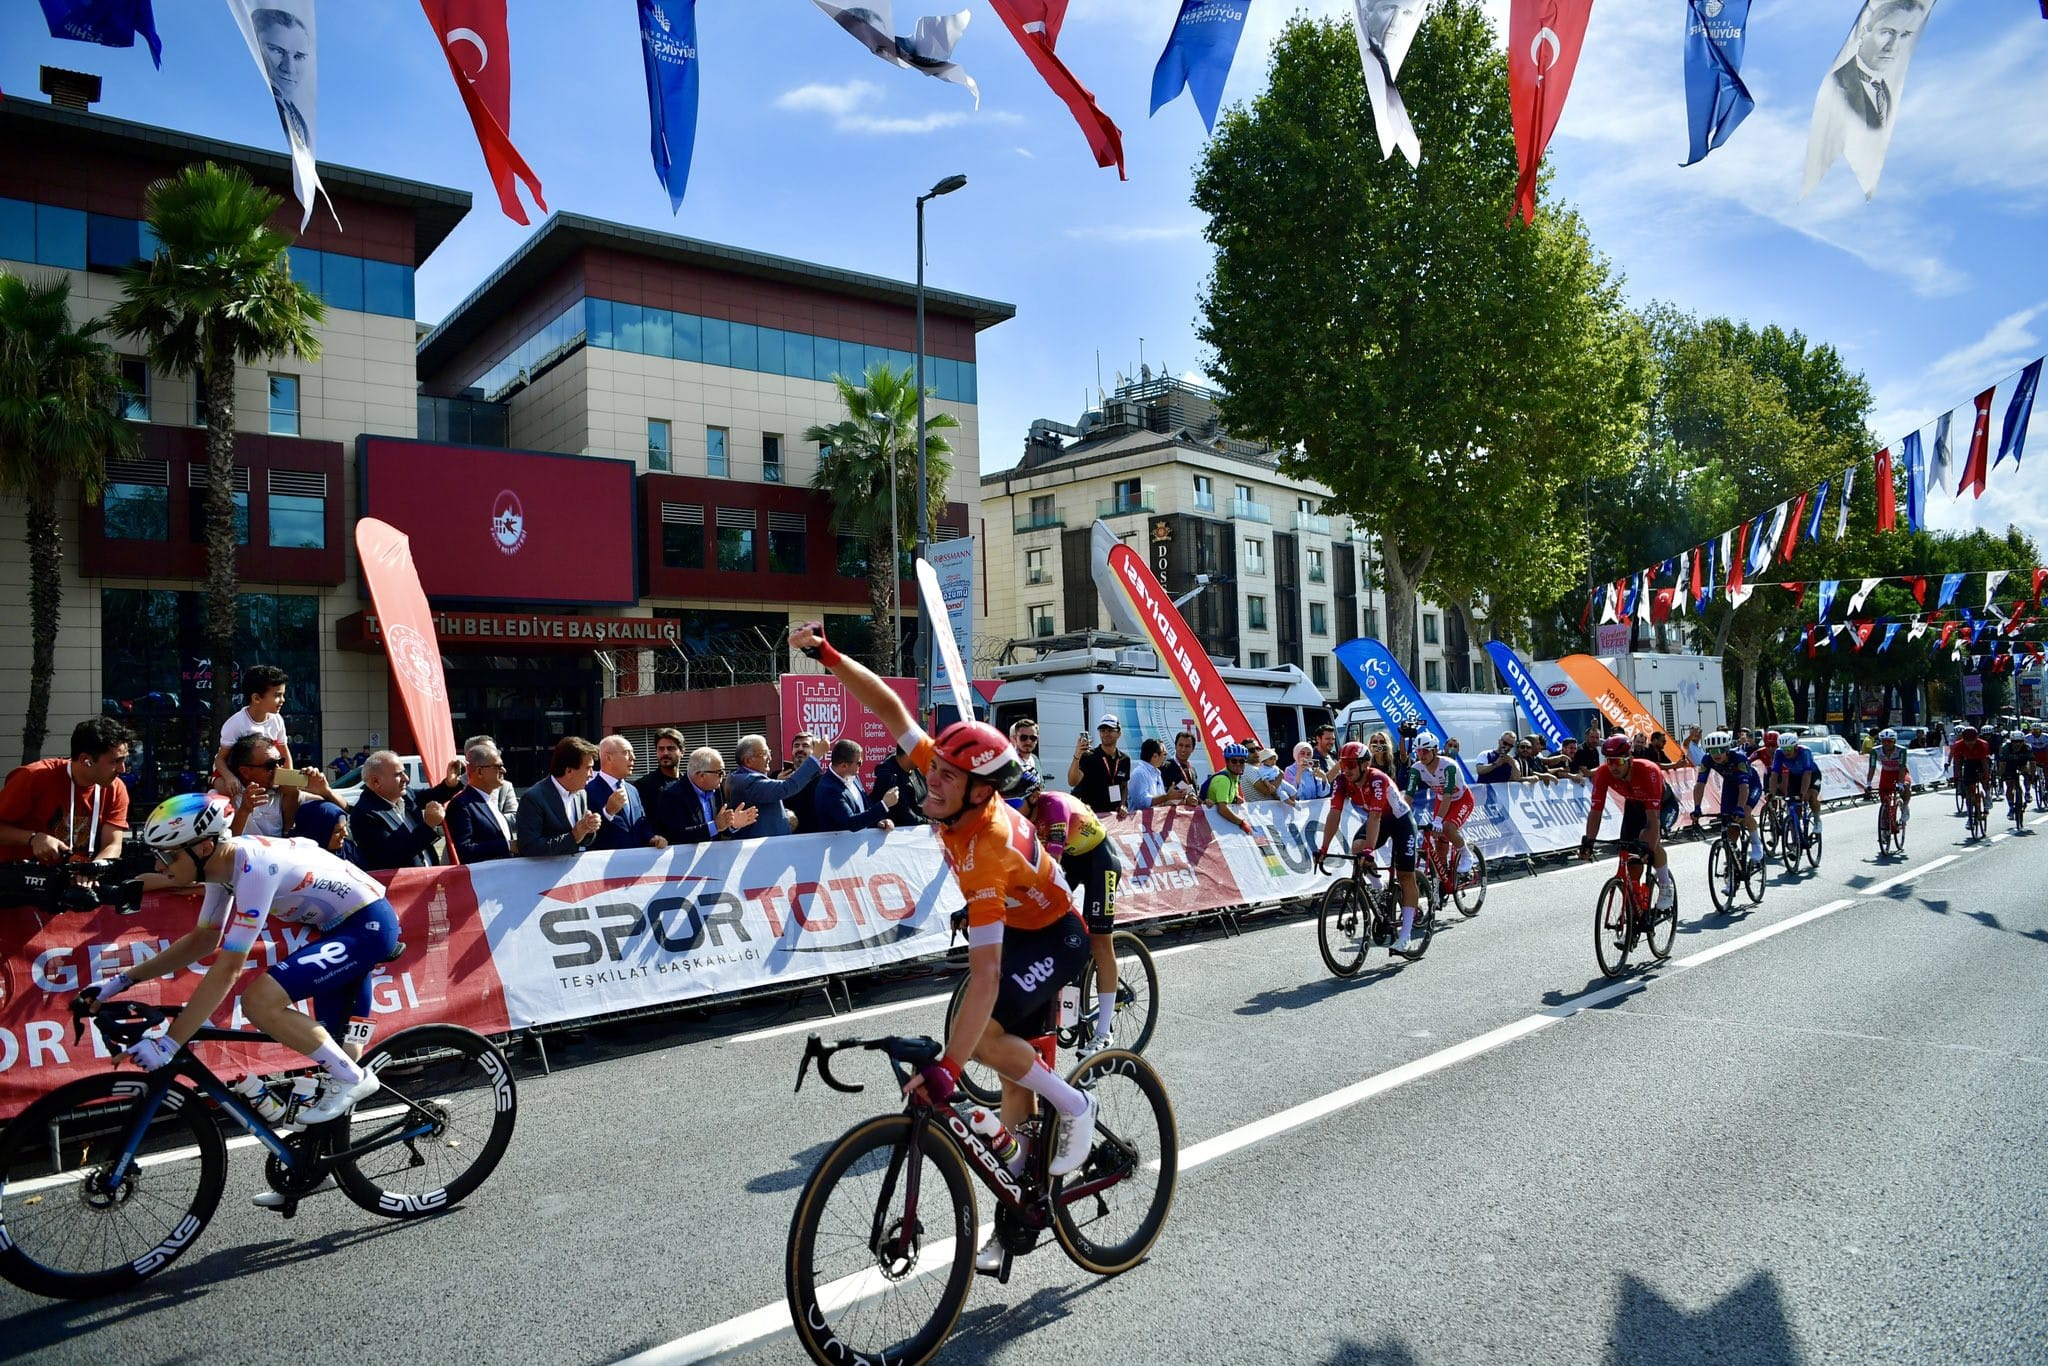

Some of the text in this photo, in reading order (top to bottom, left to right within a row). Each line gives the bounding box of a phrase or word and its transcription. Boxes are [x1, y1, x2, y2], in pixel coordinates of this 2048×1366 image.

[464, 616, 564, 637] BELEDİYE
[568, 620, 681, 641] BAŞKANLIĞI
[1550, 685, 1566, 693] TRT
[864, 722, 883, 730] Online
[971, 749, 995, 767] lotto
[25, 875, 46, 886] TRT
[560, 949, 761, 989] TEŞKİLAT BAŞKANLIĞI
[1011, 956, 1054, 992] lotto
[353, 1024, 369, 1038] 16
[950, 1116, 1022, 1204] ORBEA
